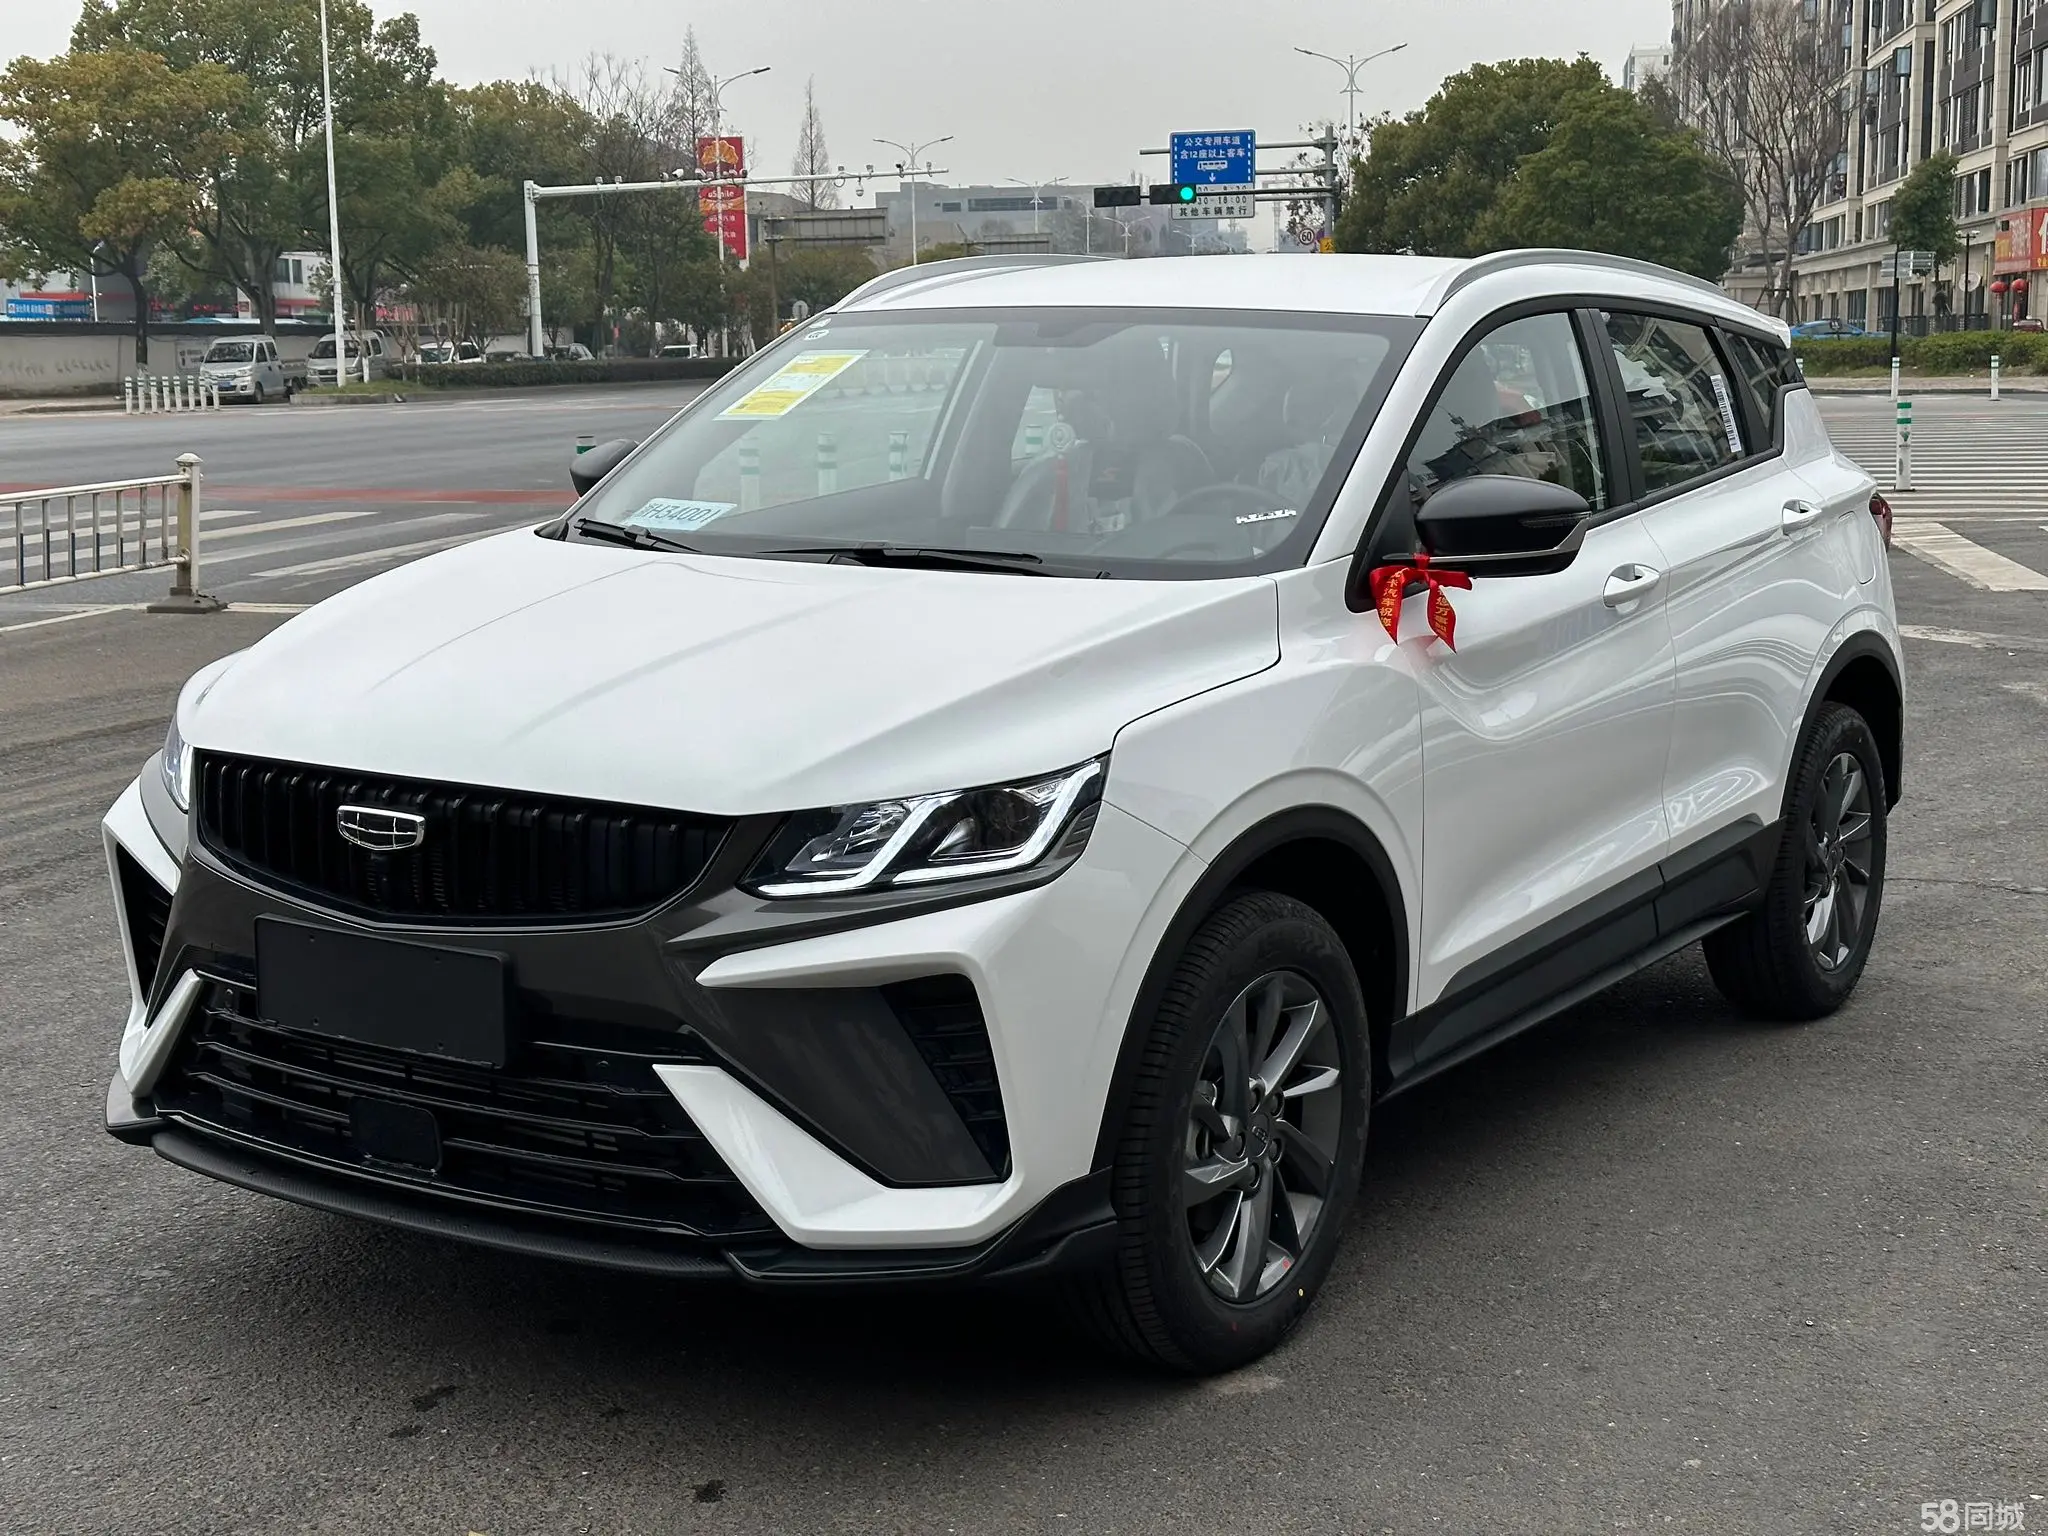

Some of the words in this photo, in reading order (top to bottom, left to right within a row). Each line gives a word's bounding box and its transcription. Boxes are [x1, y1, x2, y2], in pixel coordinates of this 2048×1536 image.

[1184, 135, 1241, 147] 公交专用车道
[1180, 148, 1246, 160] 含12座以上客车
[1180, 205, 1247, 216] 其他车辆禁行
[1302, 231, 1312, 242] 60
[638, 503, 721, 523] H34001
